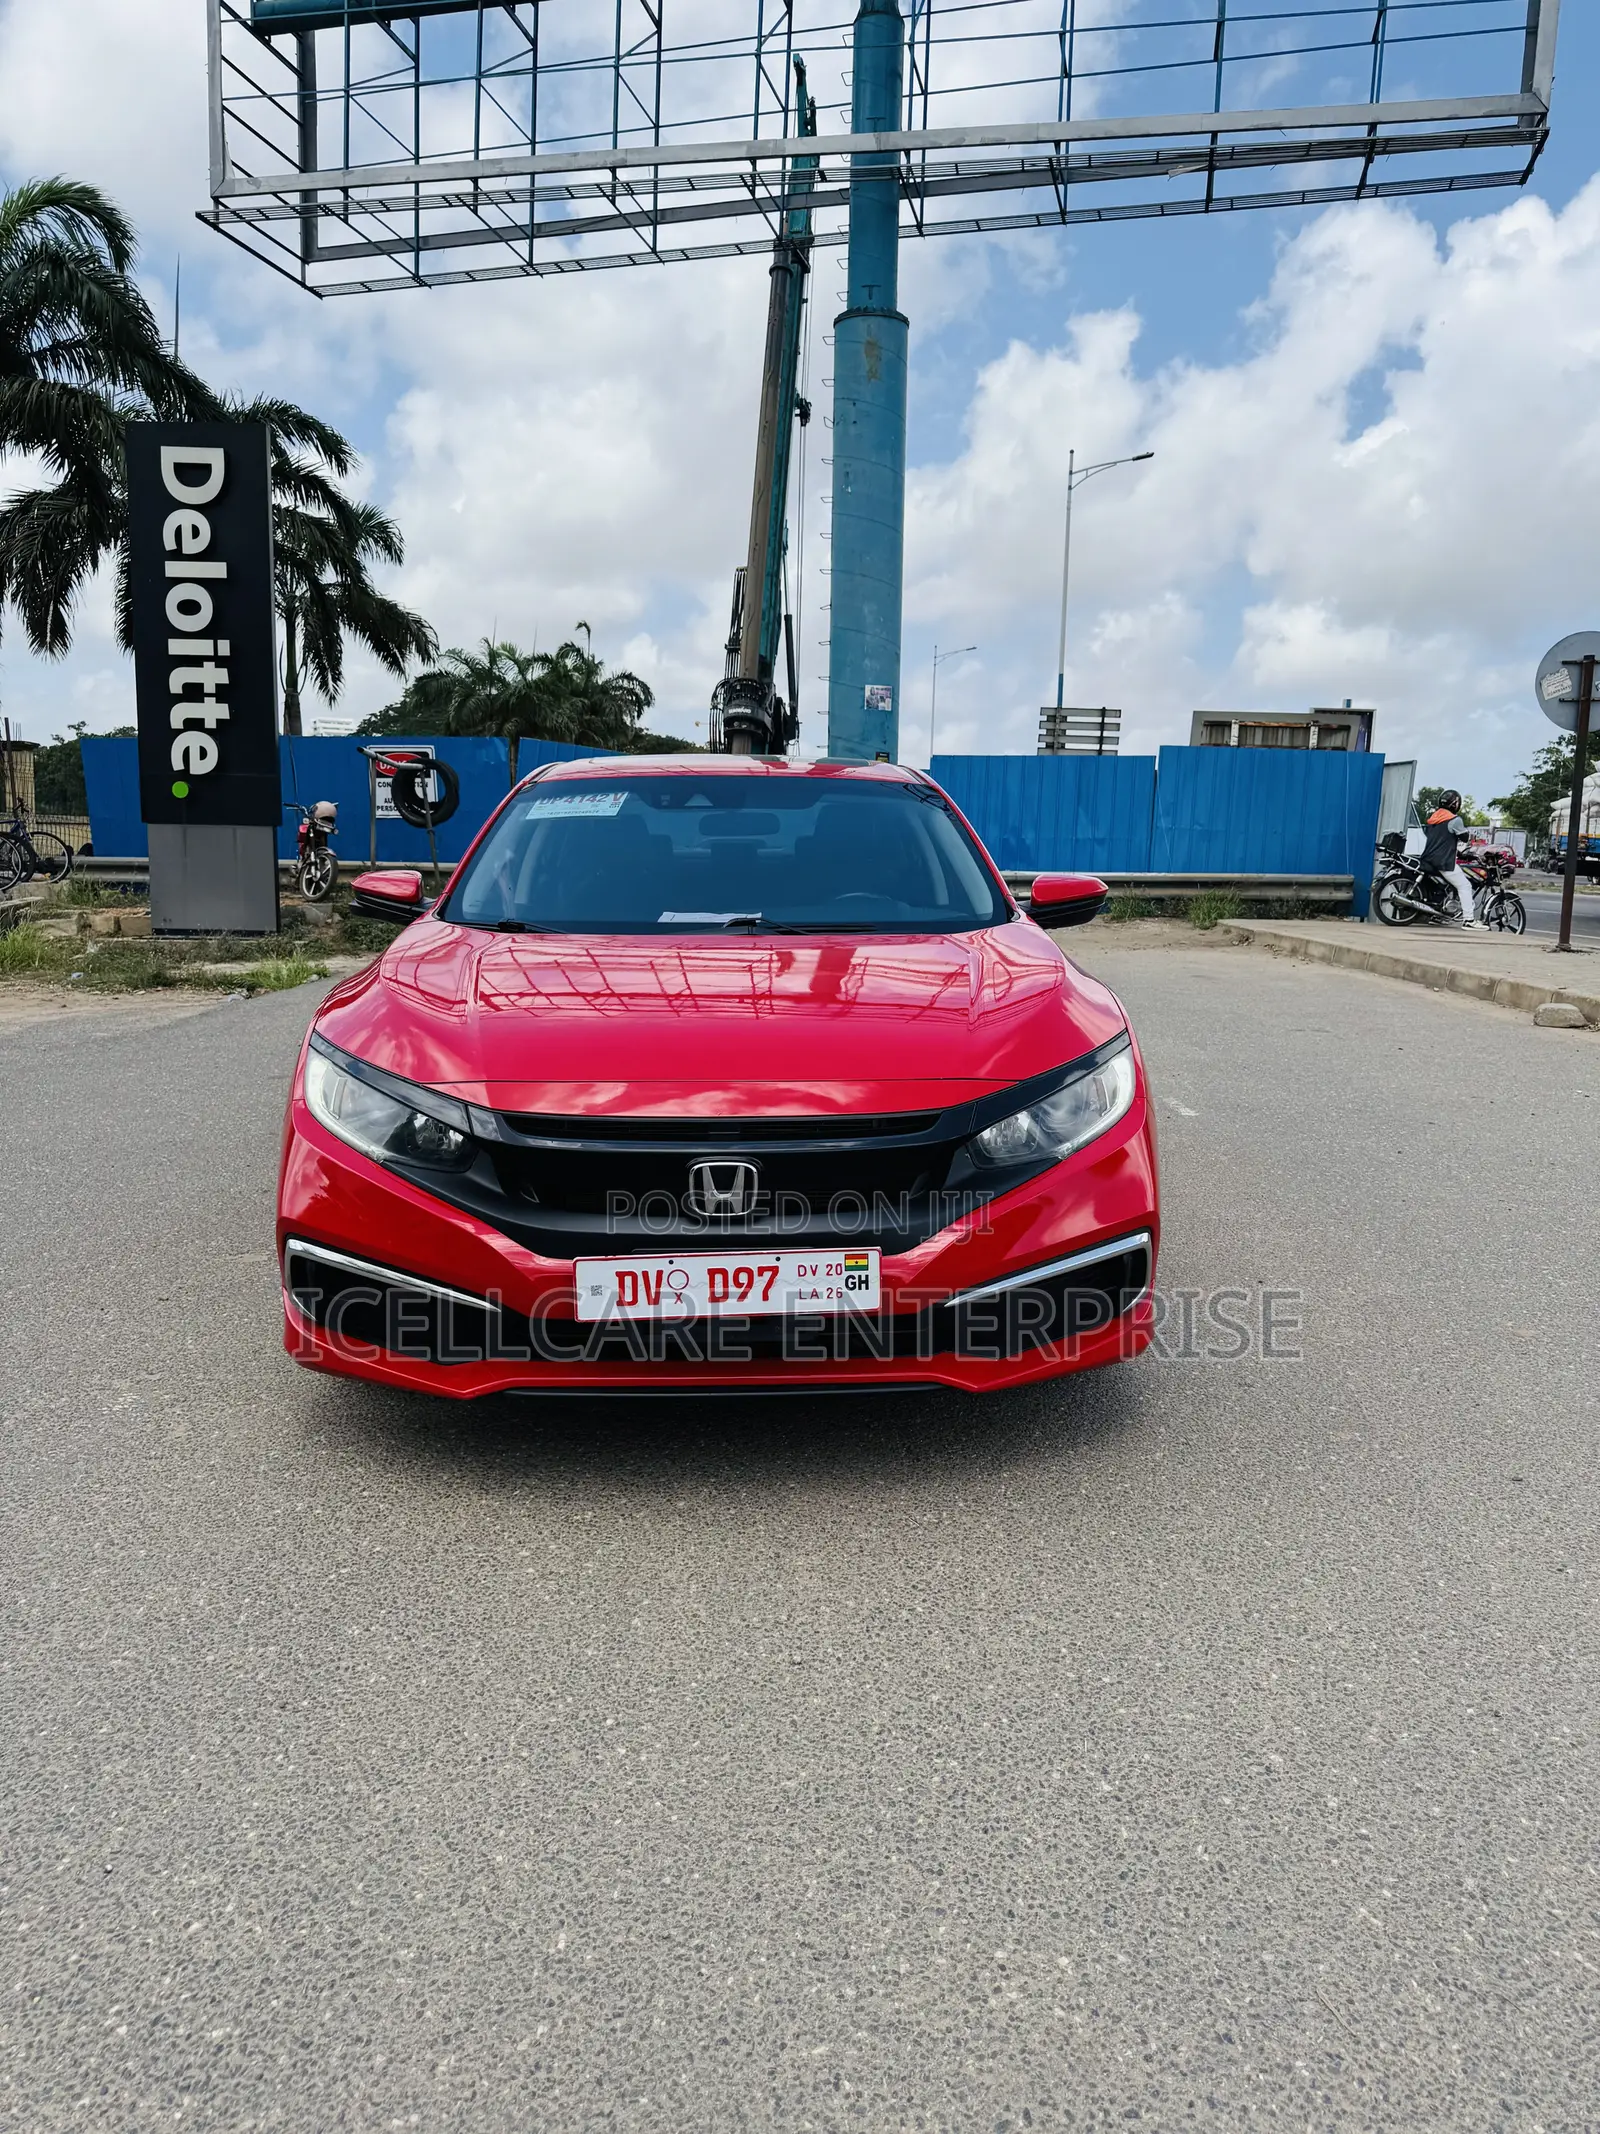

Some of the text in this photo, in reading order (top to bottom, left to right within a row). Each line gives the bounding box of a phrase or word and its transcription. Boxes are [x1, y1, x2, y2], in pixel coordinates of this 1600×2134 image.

[797, 1263, 843, 1277] DV 20
[615, 1270, 664, 1307] DV
[706, 1265, 780, 1303] D97
[845, 1274, 869, 1291] GH
[799, 1287, 843, 1300] LA 26
